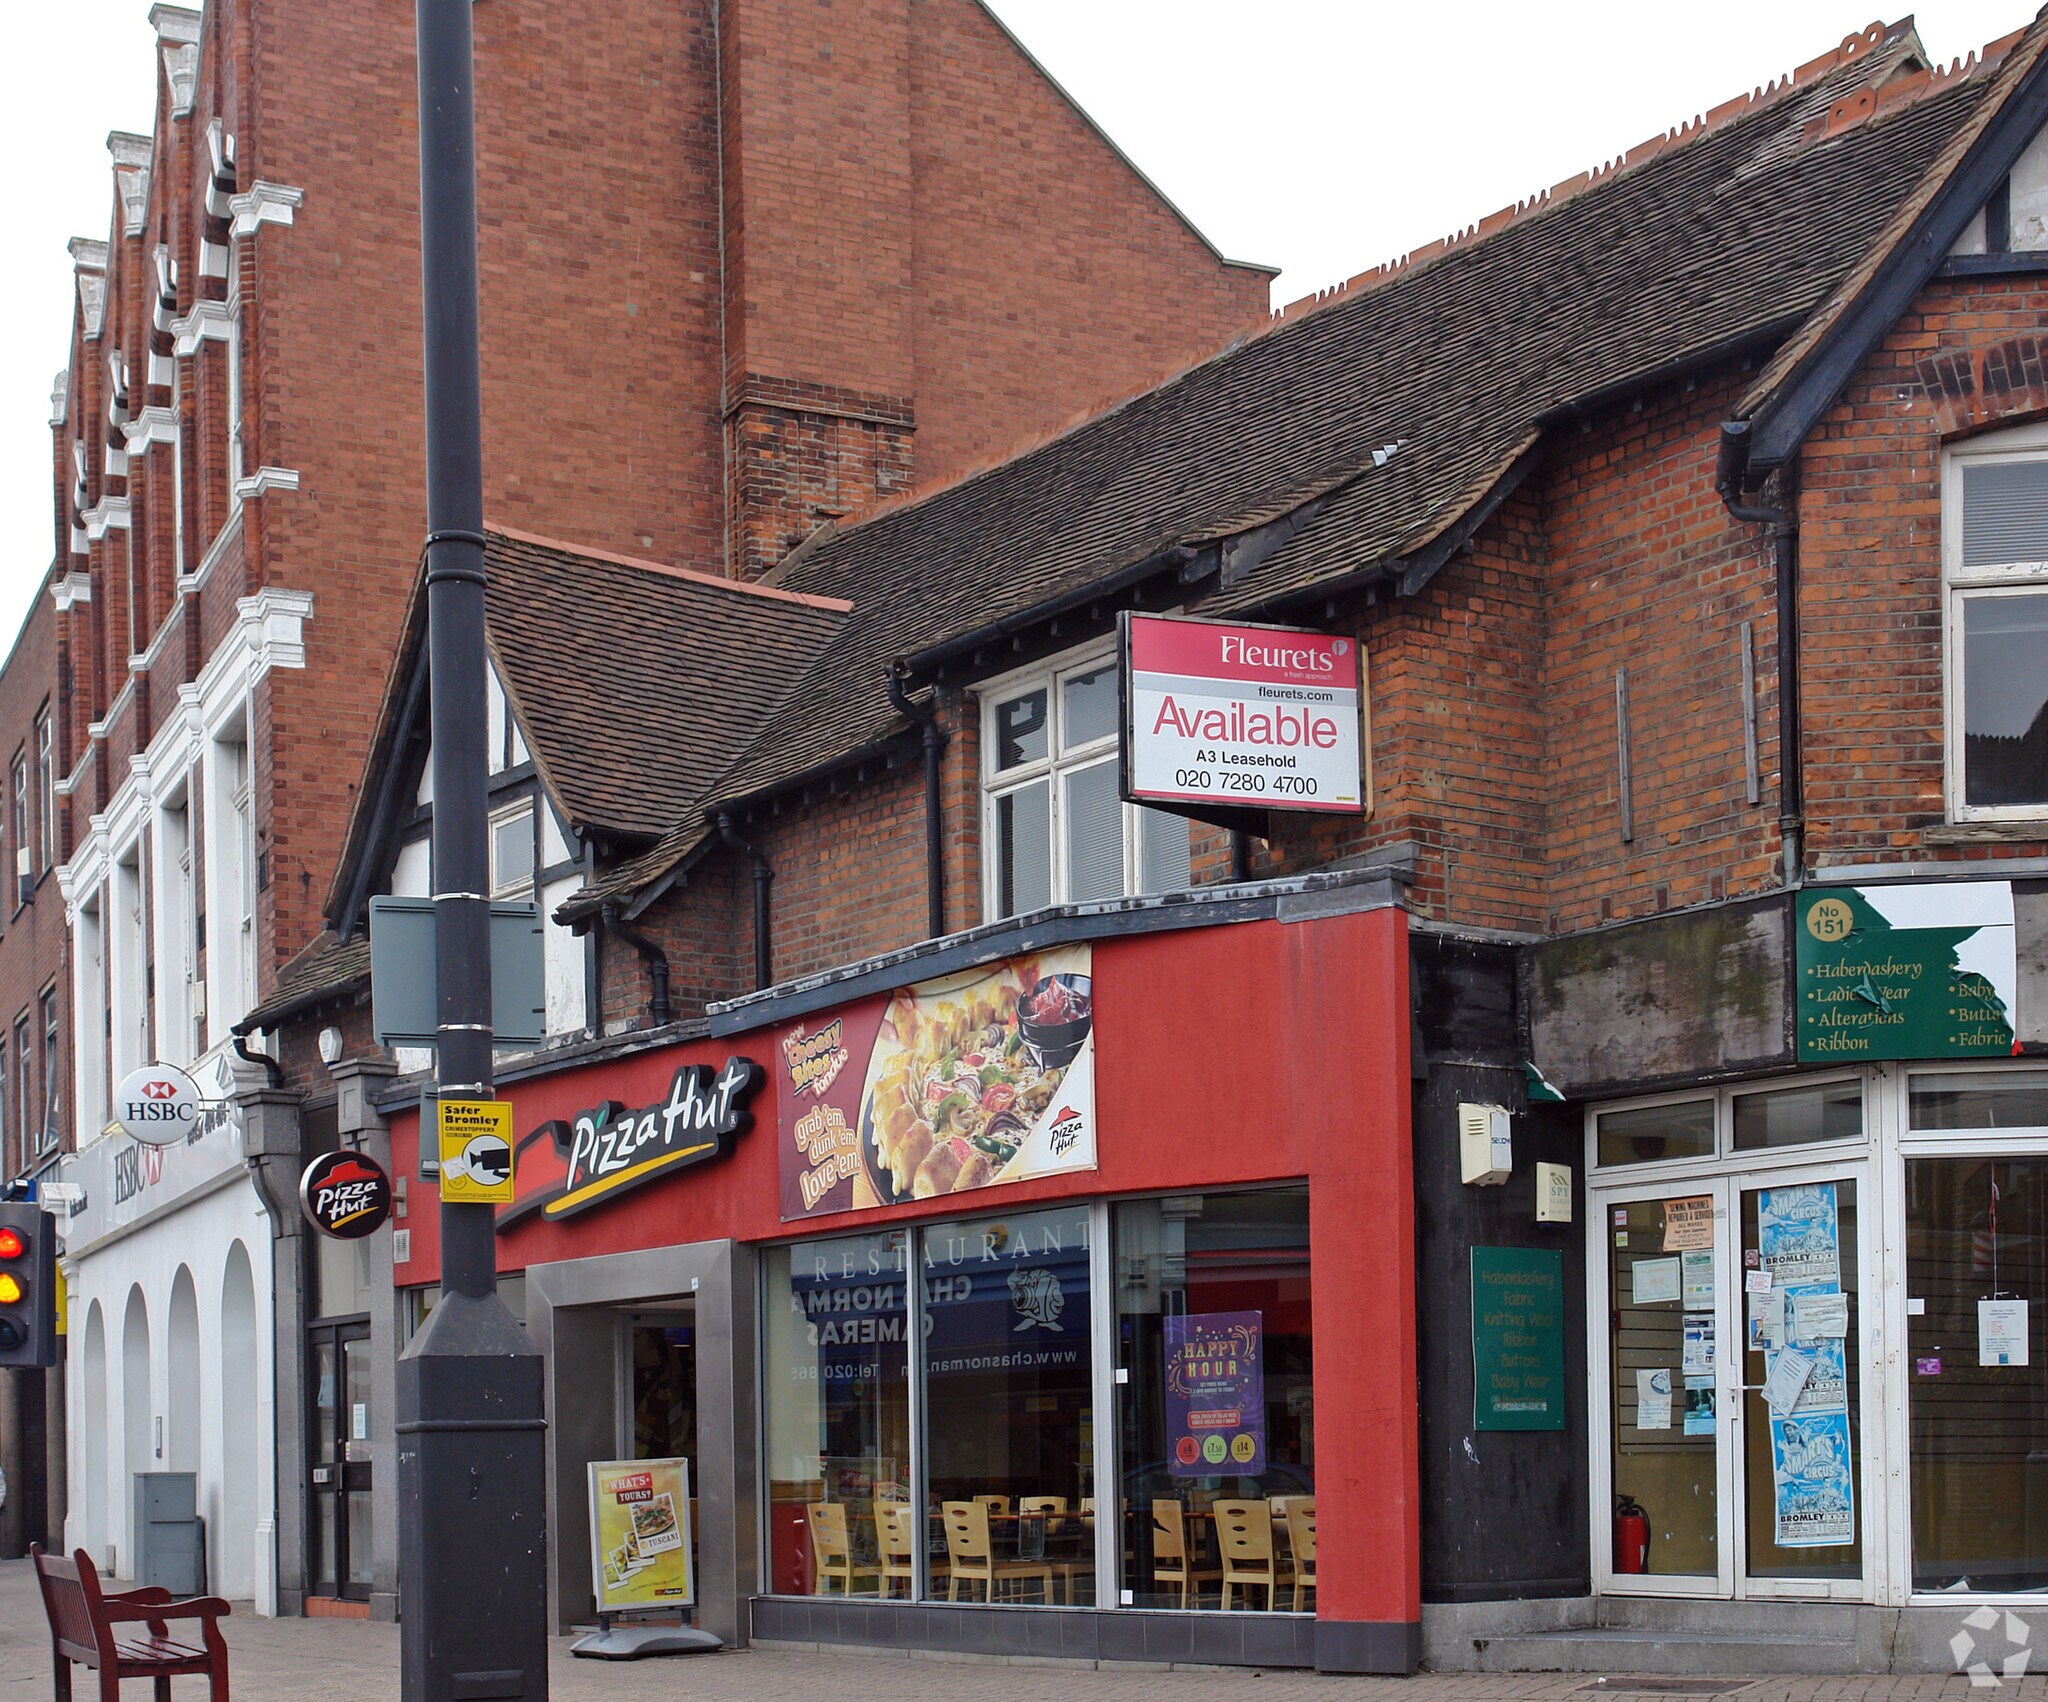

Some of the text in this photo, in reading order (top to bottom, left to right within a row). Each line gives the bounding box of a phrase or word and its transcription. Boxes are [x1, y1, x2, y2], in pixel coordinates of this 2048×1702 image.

[1220, 635, 1333, 672] Fleurets
[1259, 686, 1333, 701] fleurets.com
[1152, 695, 1338, 749] Available
[1196, 750, 1296, 768] A3 Leasehold
[1175, 769, 1317, 795] 020 7280 4700
[1819, 906, 1839, 917] No
[1813, 919, 1844, 935] 151
[1816, 956, 1922, 979] Haberdashery
[1816, 984, 1910, 1002] Ladie ear
[1958, 977, 1994, 1000] Baby
[788, 1020, 841, 1066] Cheesy
[1816, 1031, 1869, 1051] Ribbon
[1958, 1026, 2006, 1046] Fabric
[791, 1054, 831, 1088] Bites
[812, 1048, 849, 1095] fondue
[126, 1102, 194, 1122] HSBC
[445, 1105, 480, 1114] Safer
[445, 1115, 499, 1126] Bromley
[566, 1065, 745, 1191] Pizza Hut
[797, 1111, 822, 1145] grab
[812, 1130, 837, 1159] dunk
[1050, 1122, 1083, 1150] Pizza
[1055, 1134, 1079, 1155] Hut
[114, 1142, 145, 1205] HSBC
[803, 1163, 834, 1203] love
[1551, 1187, 1569, 1197] SPY
[317, 1181, 378, 1215] Pizza
[1688, 1200, 1709, 1210] MACHINES
[329, 1195, 374, 1221] Hut
[1668, 1212, 1688, 1222] REPAIRED
[1791, 1206, 1821, 1219] CIRCUS
[1766, 1253, 1811, 1265] BROMLEY
[1481, 1270, 1555, 1290] Haberdashery
[1503, 1291, 1535, 1306] Fabric
[1483, 1312, 1554, 1330] Knitting Wool
[1503, 1332, 1537, 1347] Ribbon
[1184, 1340, 1239, 1359] HAPPY
[1186, 1360, 1238, 1378] HOUR
[1501, 1354, 1541, 1368] Buttons
[1491, 1374, 1549, 1392] Baby Wear
[1207, 1443, 1222, 1453] £7.50
[1237, 1442, 1248, 1452] £14
[1803, 1466, 1834, 1479] CIRCUS
[609, 1475, 646, 1490] WHAT'S
[619, 1490, 651, 1502] YOURS?
[1780, 1513, 1825, 1523] BROMLEY
[648, 1532, 679, 1547] TUSCANI
